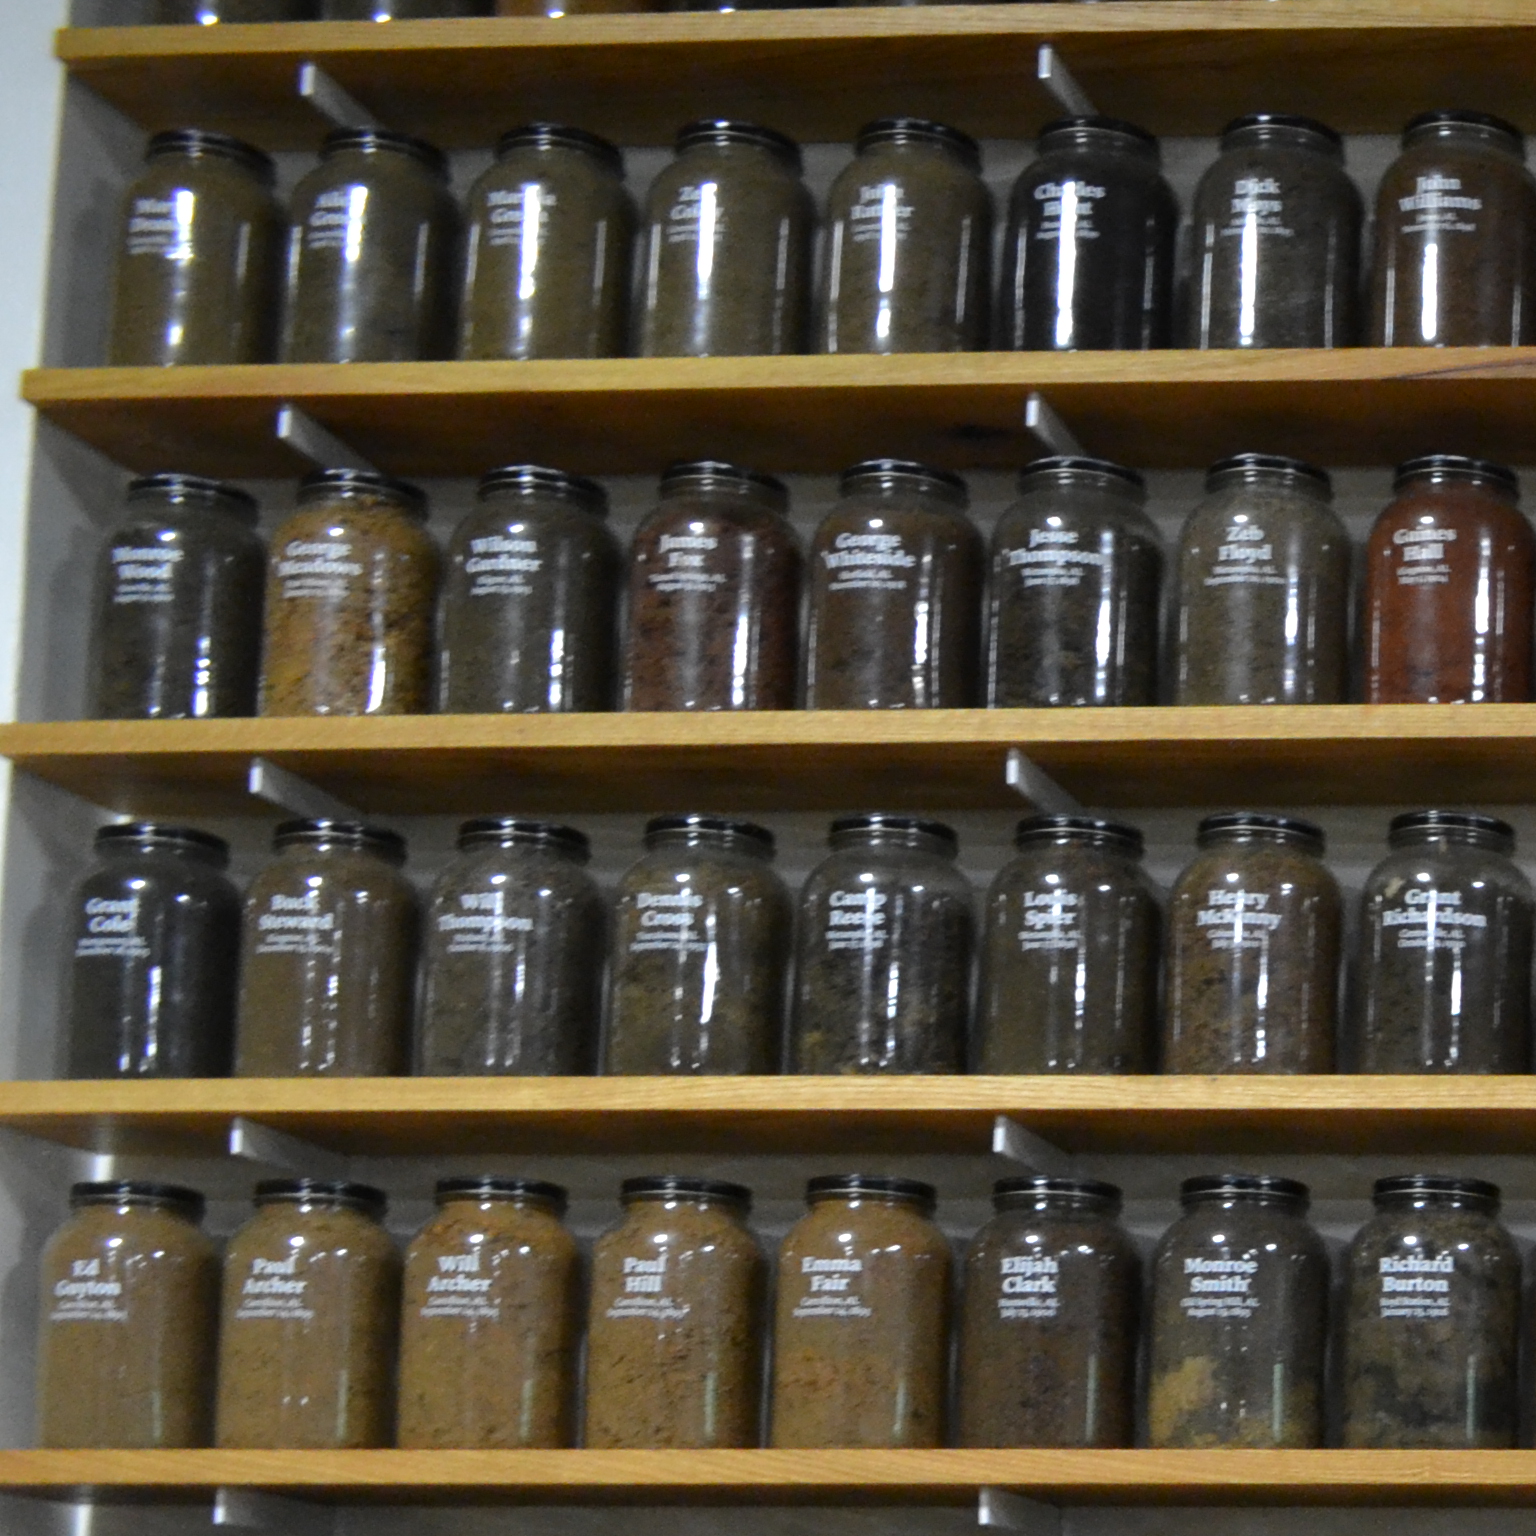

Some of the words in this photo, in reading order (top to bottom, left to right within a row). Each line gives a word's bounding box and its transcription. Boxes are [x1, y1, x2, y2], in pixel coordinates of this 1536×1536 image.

[801, 1256, 863, 1273] Emma
[1000, 1257, 1059, 1276] Elijah
[810, 1274, 851, 1292] Fair
[1001, 1276, 1057, 1294] Clark
